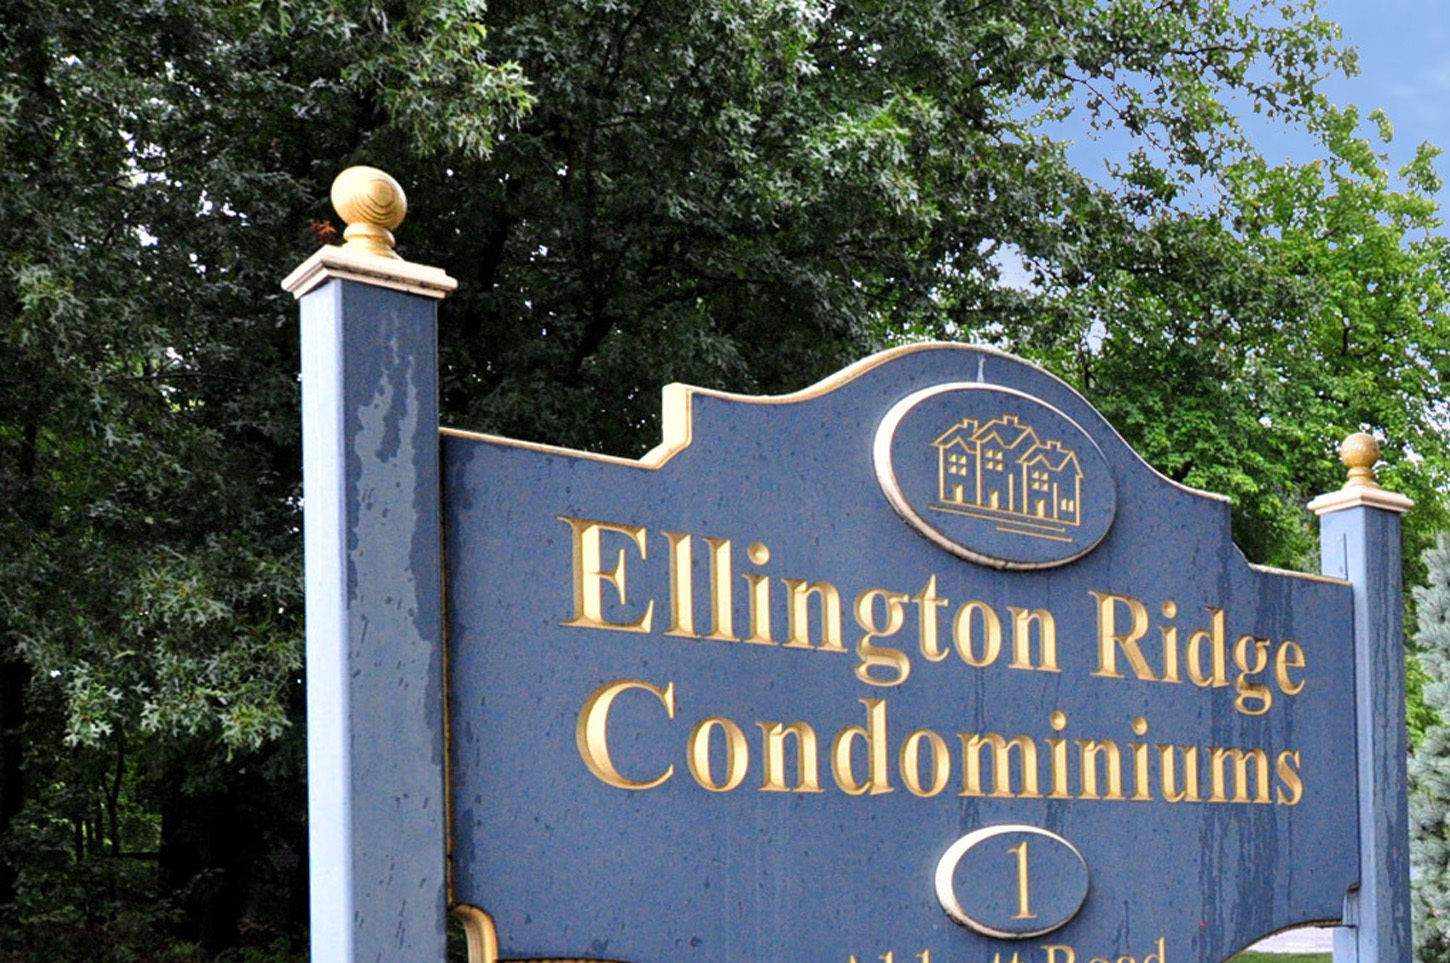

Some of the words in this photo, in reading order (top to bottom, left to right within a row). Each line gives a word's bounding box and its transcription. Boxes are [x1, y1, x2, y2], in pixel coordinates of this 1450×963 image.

[556, 515, 1061, 686] Ellington
[1088, 590, 1306, 715] Ridge
[576, 678, 1303, 806] Condominiums
[1007, 840, 1037, 920] 1
